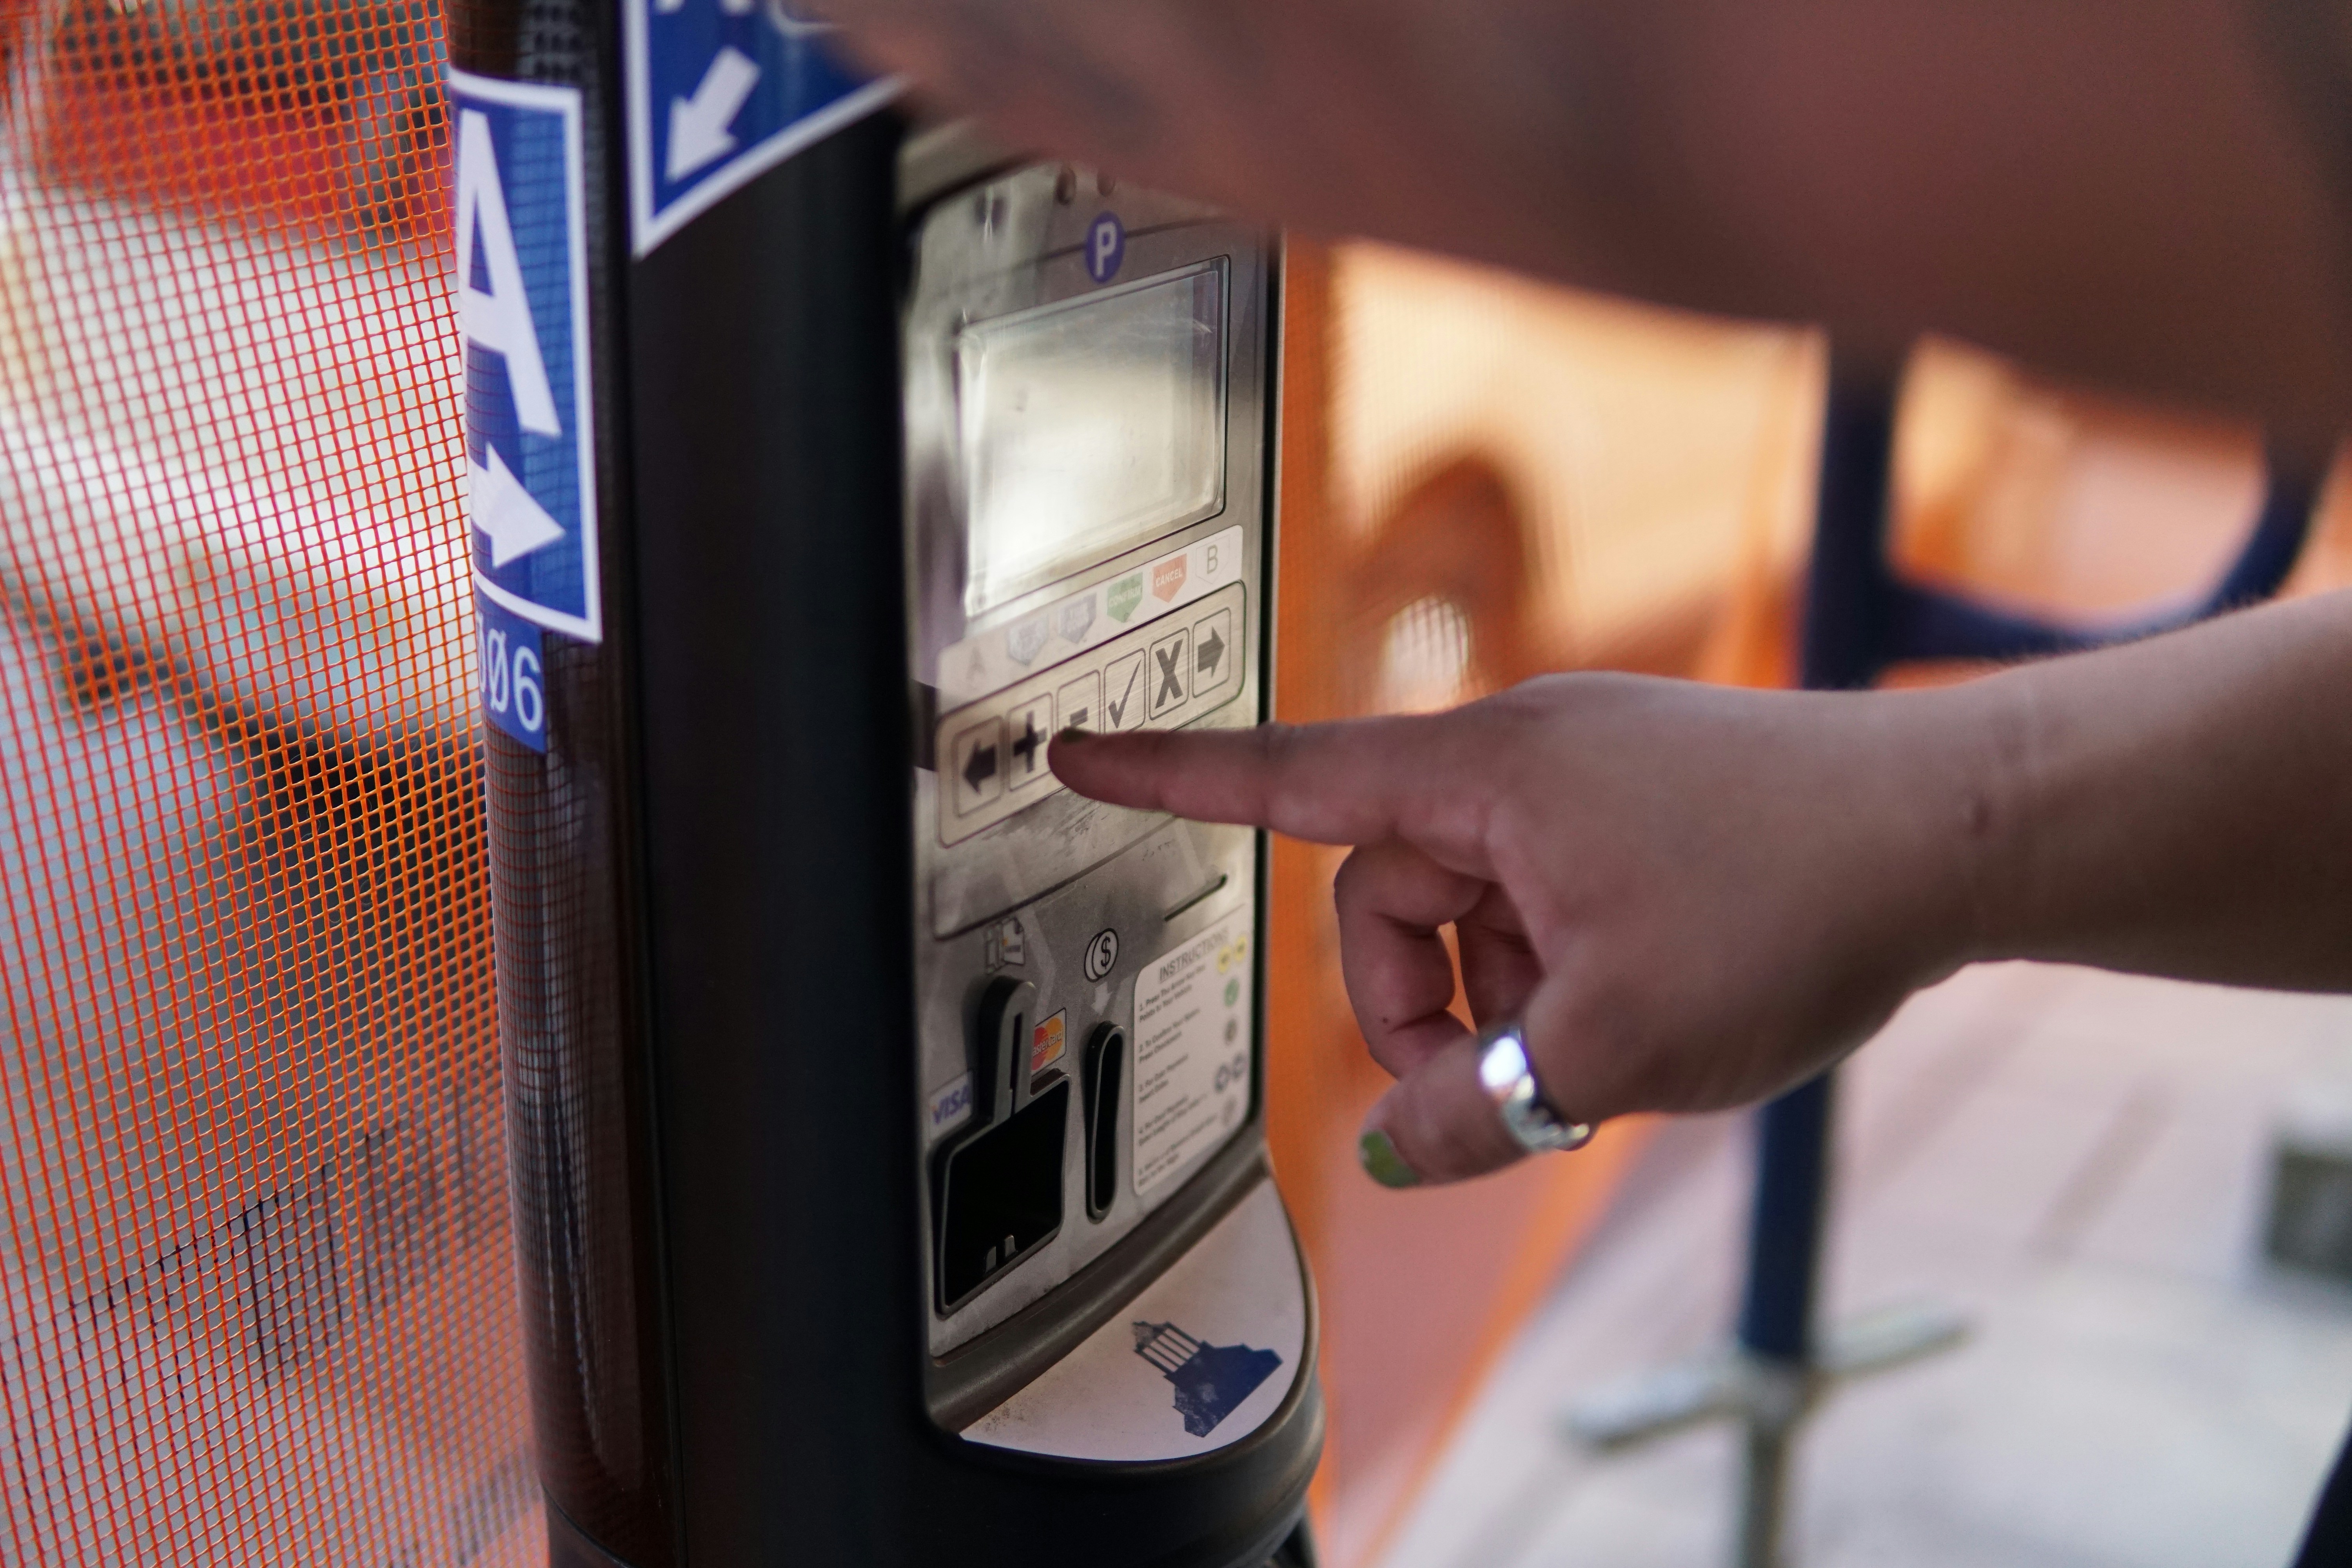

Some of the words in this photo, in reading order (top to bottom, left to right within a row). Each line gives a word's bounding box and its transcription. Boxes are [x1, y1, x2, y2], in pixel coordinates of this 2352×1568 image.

[1096, 221, 1116, 277] P
[455, 107, 563, 437] A
[1207, 544, 1218, 574] B
[1155, 568, 1183, 587] CANCEL
[1033, 1029, 1064, 1056] asterCard
[931, 1083, 971, 1125] VISA
